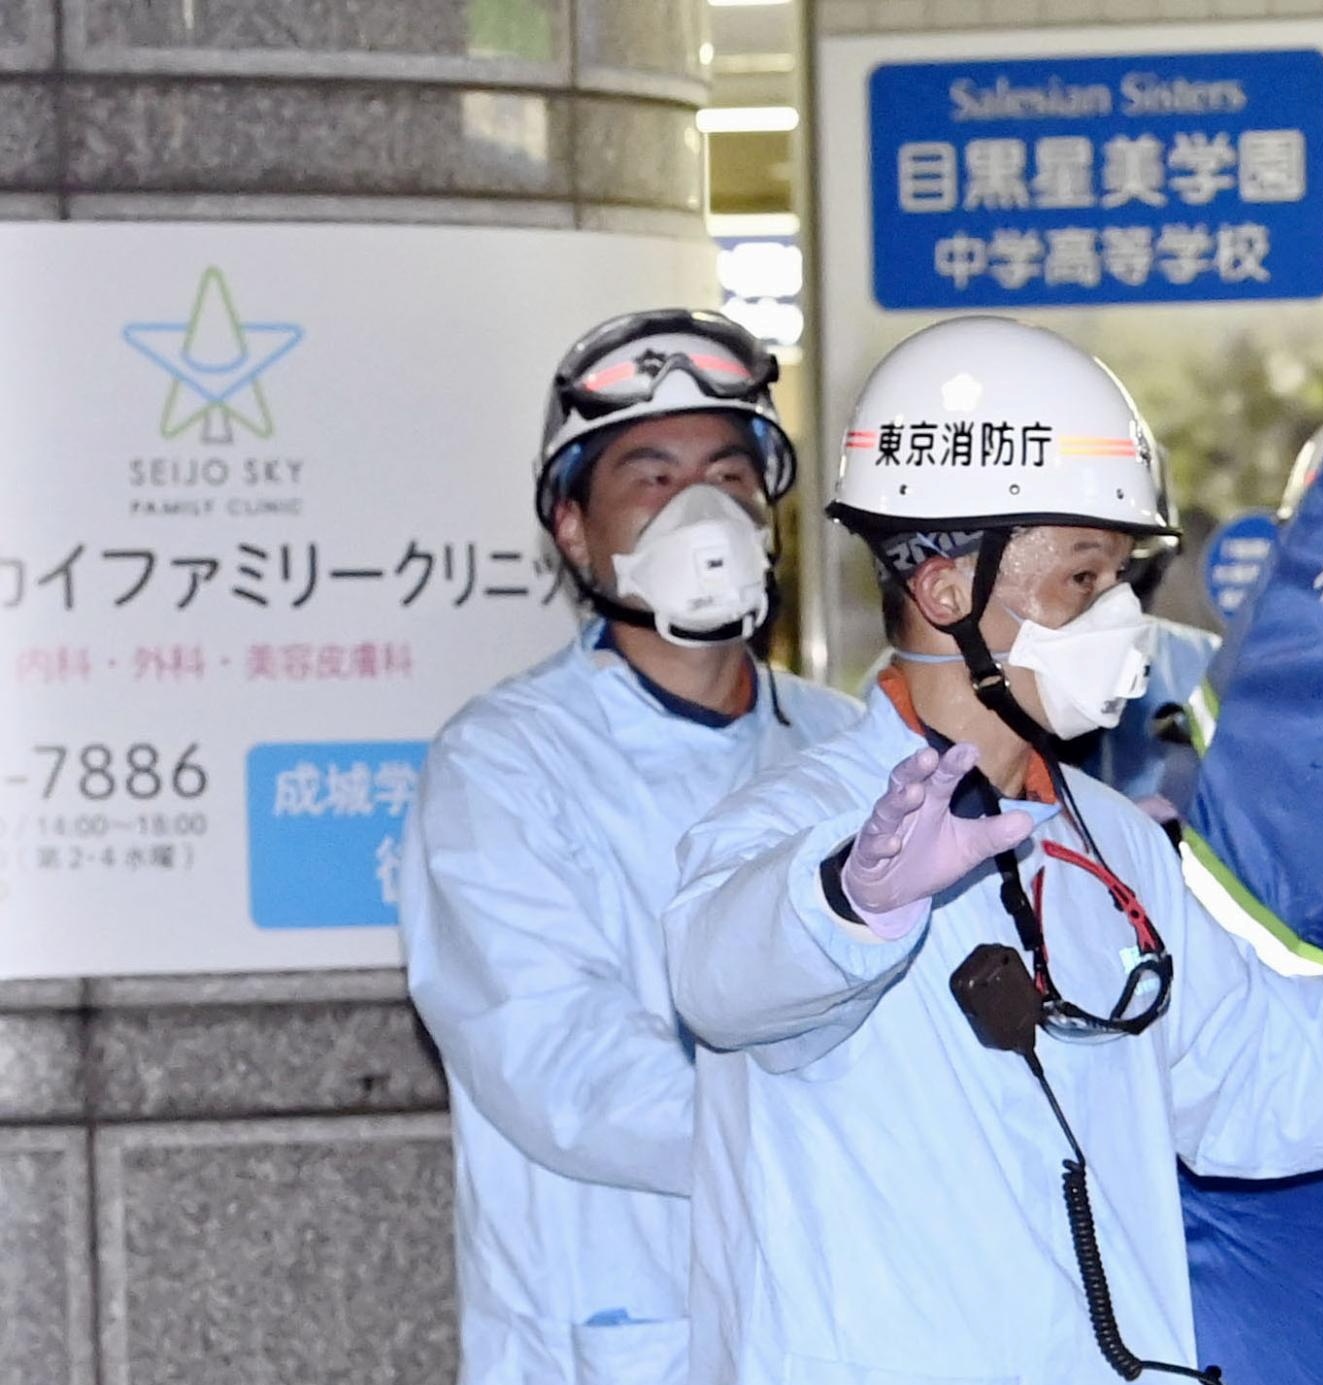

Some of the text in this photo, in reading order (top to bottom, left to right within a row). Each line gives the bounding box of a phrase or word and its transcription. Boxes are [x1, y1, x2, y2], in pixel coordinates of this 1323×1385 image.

[899, 129, 1307, 213] 目黒星美学園
[934, 221, 1271, 289] 中学高等学校
[129, 457, 304, 487] SEIJO SKY
[875, 421, 1053, 467] 東京消防庁
